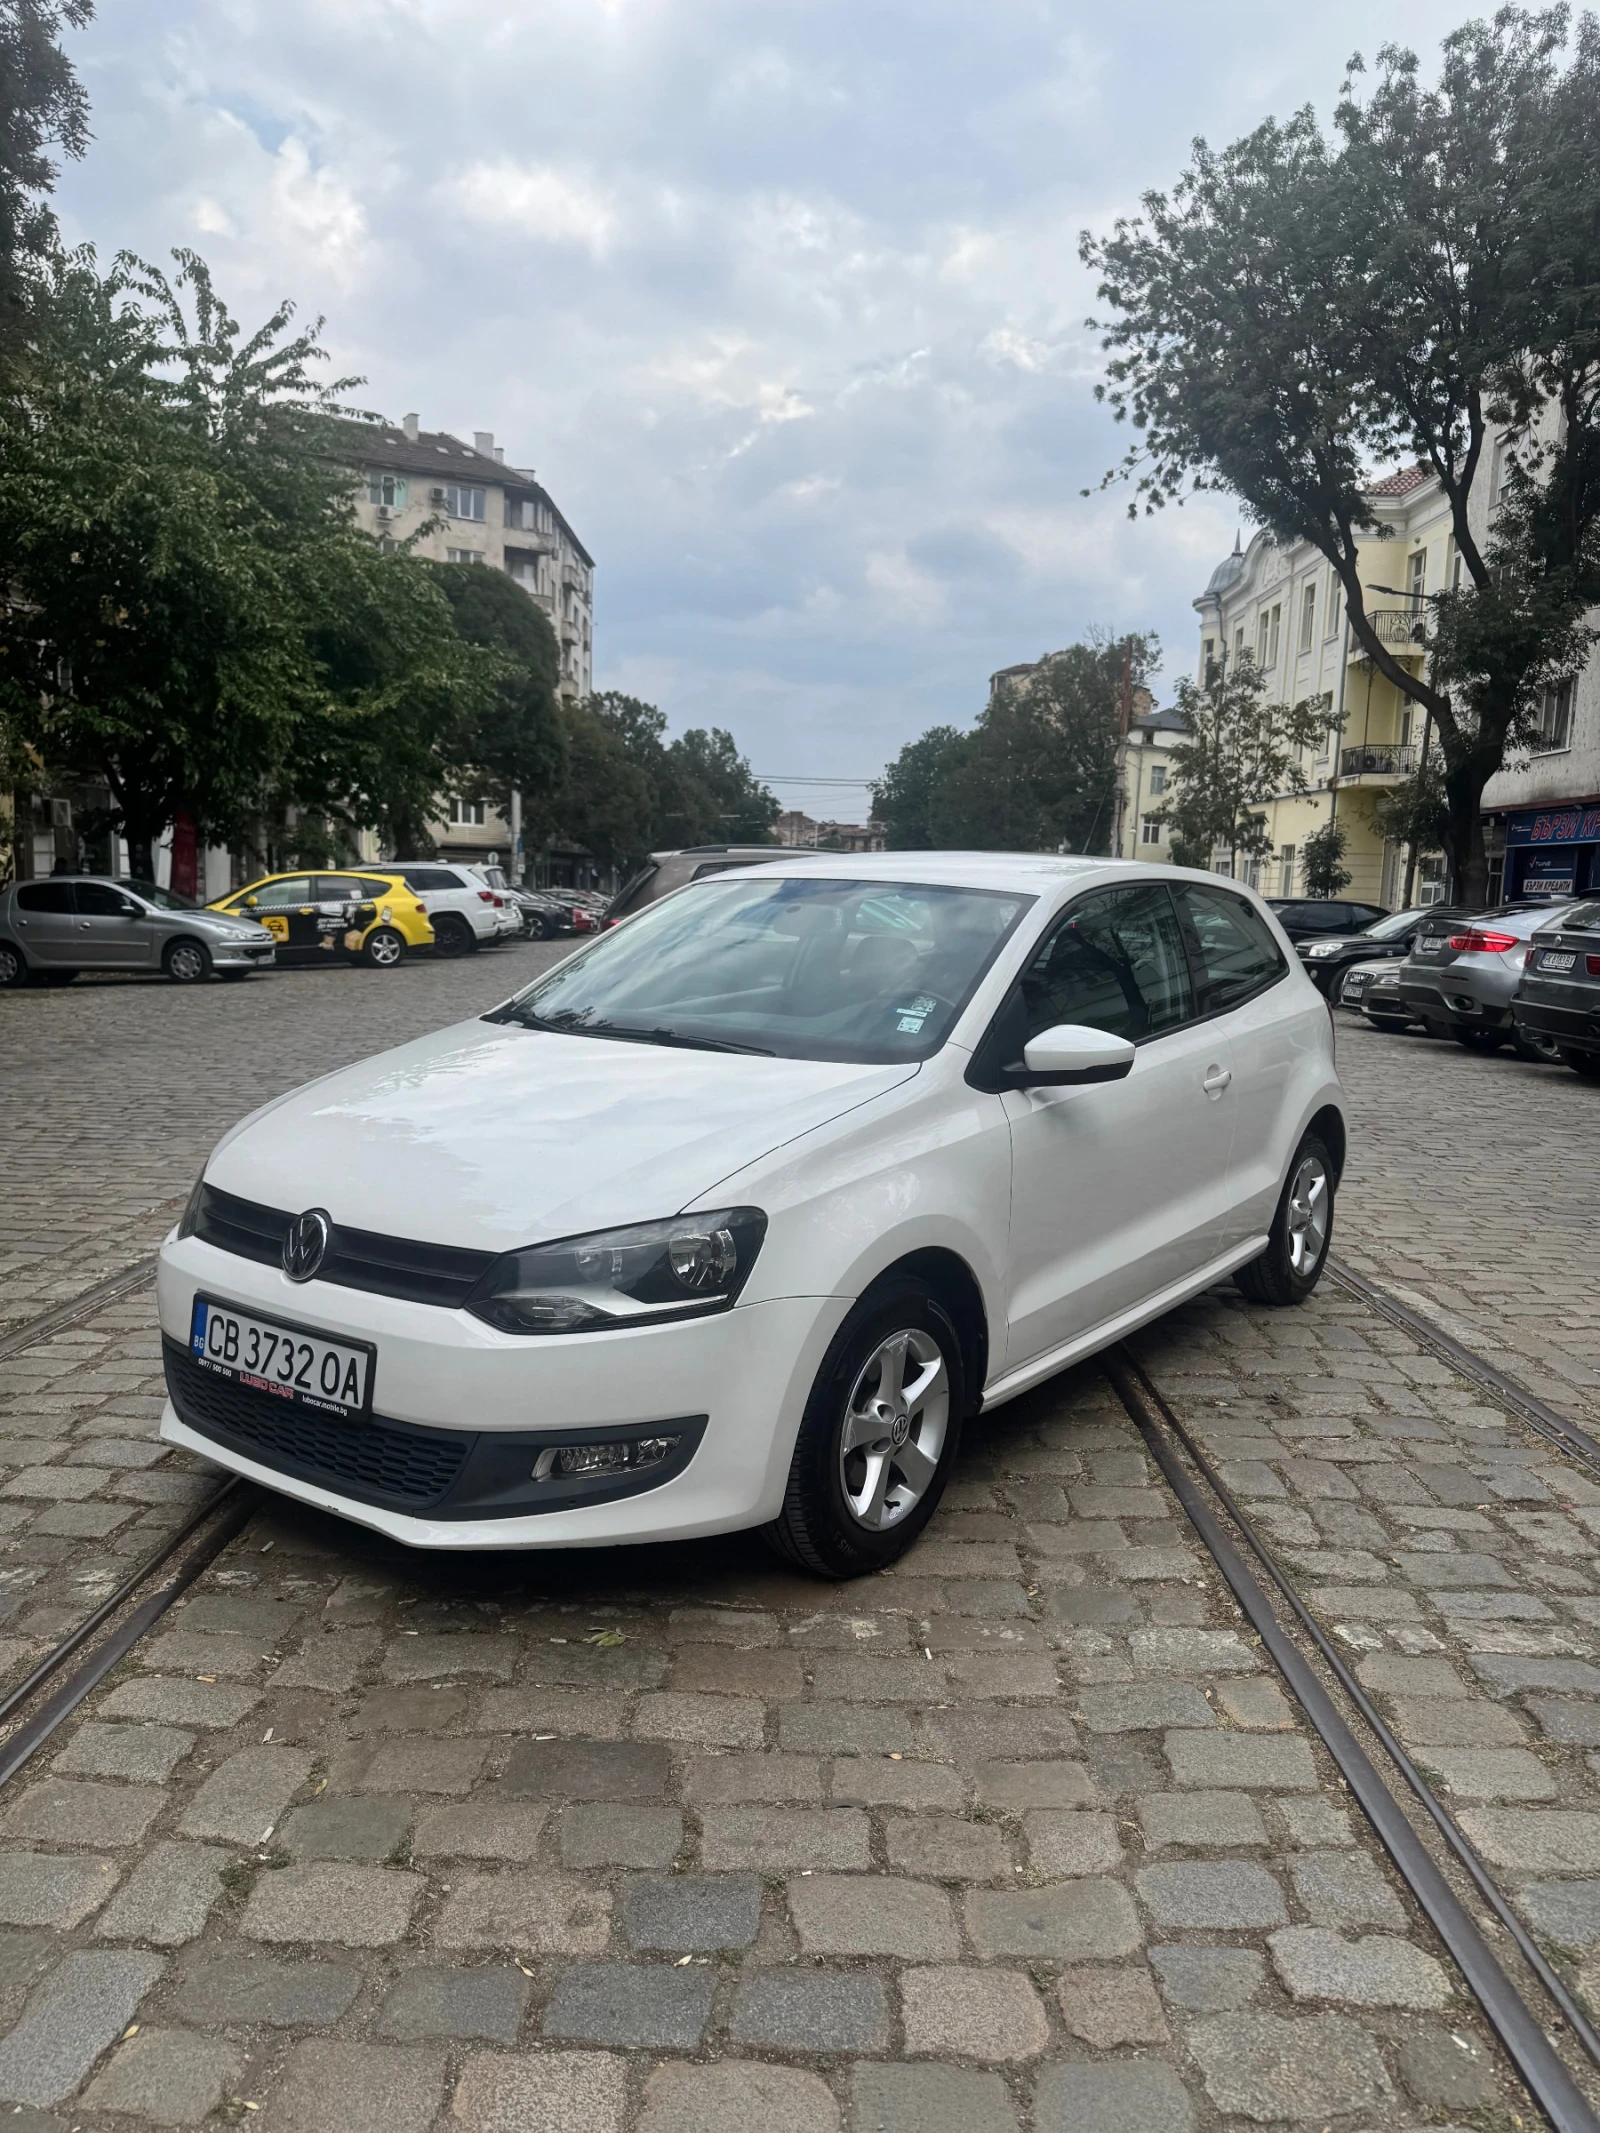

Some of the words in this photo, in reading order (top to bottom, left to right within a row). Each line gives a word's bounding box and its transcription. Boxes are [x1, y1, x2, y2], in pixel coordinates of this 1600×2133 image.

[1531, 812, 1582, 840] БЪРЗИ
[1525, 881, 1544, 891] БЪРЗИ
[1544, 880, 1571, 892] КРЕДИТИ
[194, 1335, 204, 1350] BG
[208, 1314, 240, 1363] CB
[244, 1327, 315, 1390] 3732
[212, 1364, 221, 1373] 500
[222, 1368, 232, 1377] 500
[302, 1394, 348, 1416] lubocar.mobile.bg
